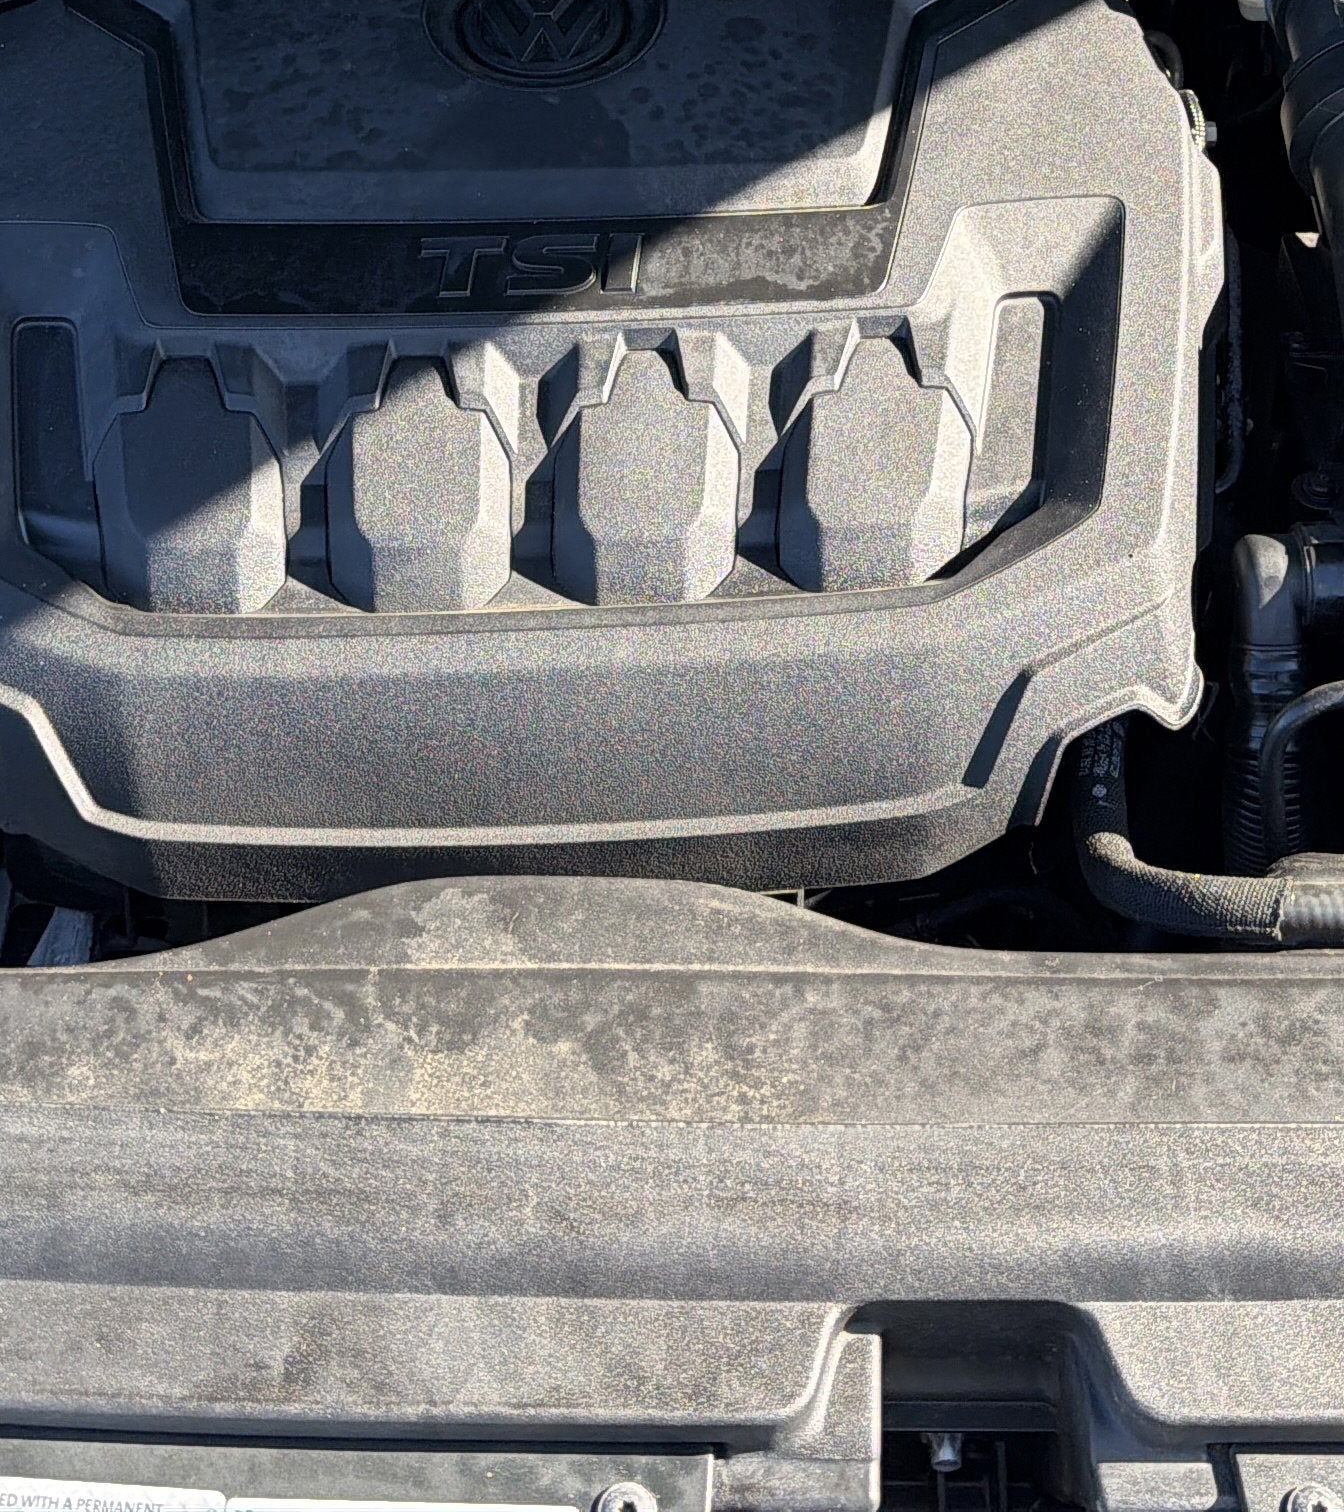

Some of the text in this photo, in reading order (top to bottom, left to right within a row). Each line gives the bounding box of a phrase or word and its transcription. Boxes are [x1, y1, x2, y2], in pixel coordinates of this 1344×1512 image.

[417, 232, 644, 298] TSI
[20, 1495, 60, 1509] WITH
[62, 1498, 73, 1510] A
[76, 1499, 165, 1512] PERMANENT
